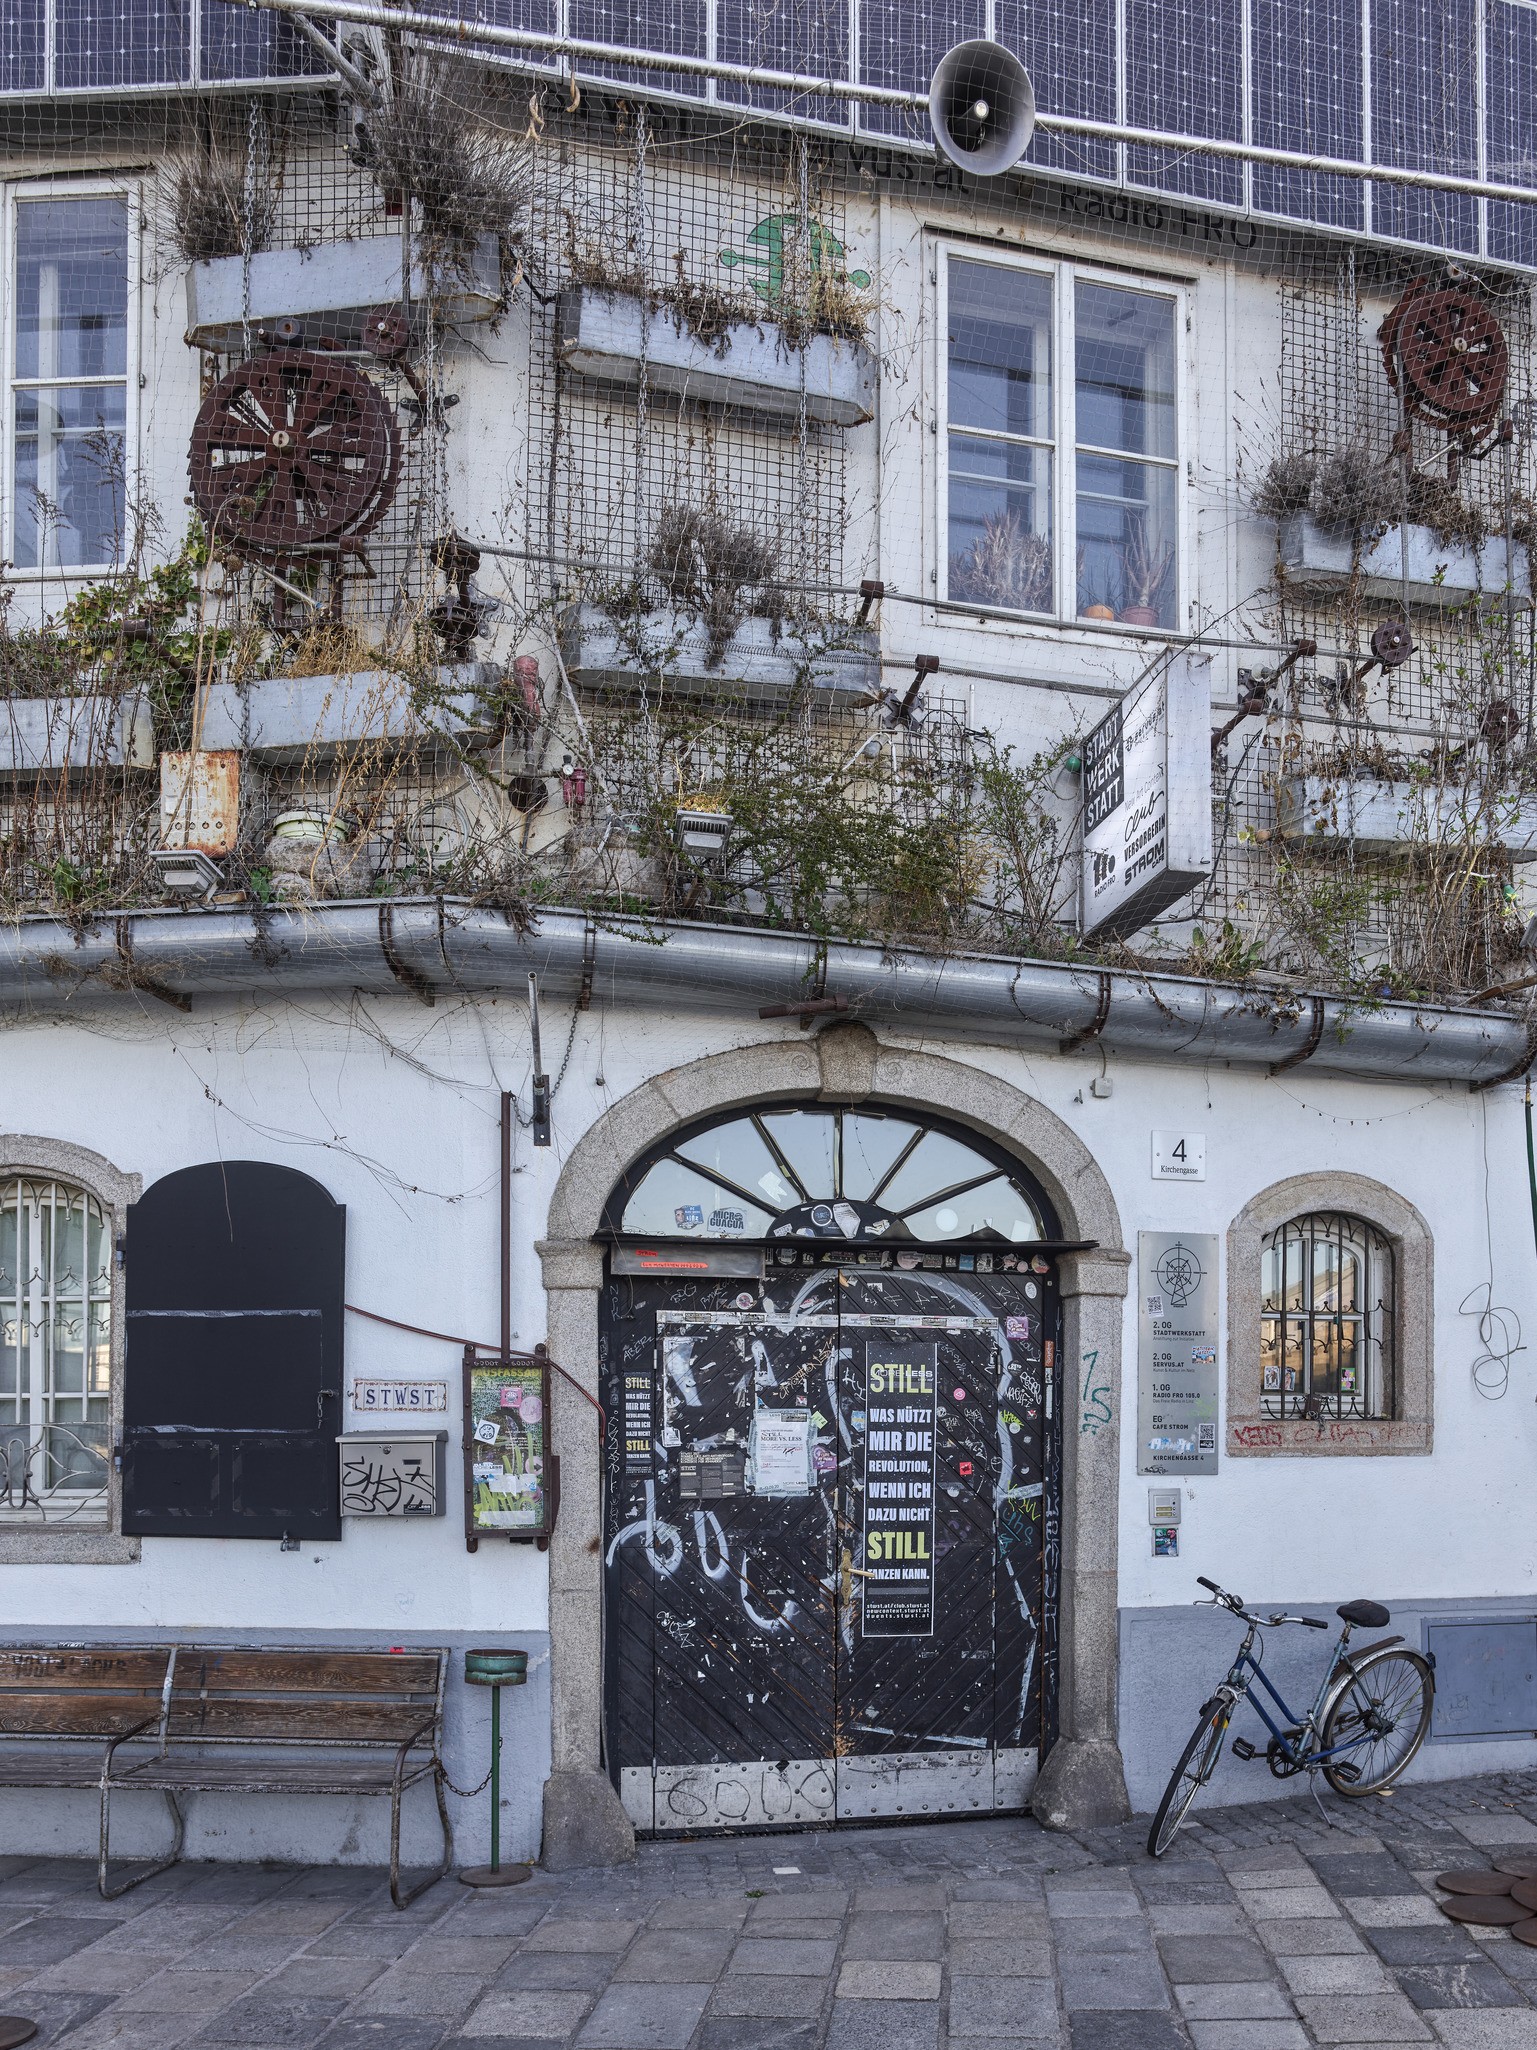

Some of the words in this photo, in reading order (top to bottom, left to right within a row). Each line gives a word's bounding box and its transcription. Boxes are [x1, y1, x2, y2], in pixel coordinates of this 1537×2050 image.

[1060, 183, 1162, 230] Radio
[1180, 208, 1257, 250] FRO
[1086, 711, 1119, 766] STADT
[1087, 743, 1120, 796] WERK
[1087, 776, 1120, 828] STATT
[1124, 813, 1166, 862] VERSORGERIN
[1124, 837, 1165, 886] STROM
[1094, 882, 1107, 898] RADIO
[1107, 874, 1116, 888] FRO
[1171, 1138, 1188, 1163] 4
[1160, 1165, 1199, 1176] Kirchengasse
[710, 1217, 745, 1230] GUAGUA
[1153, 1321, 1160, 1329] 2.
[1161, 1321, 1172, 1329] OG
[1161, 1353, 1172, 1361] OG
[473, 1367, 542, 1377] AUSFASSAD
[870, 1363, 933, 1394] STILL
[905, 1370, 933, 1378] LESS
[625, 1377, 651, 1389] STILL
[366, 1387, 435, 1405] STWST
[625, 1402, 639, 1411] MIR
[640, 1402, 651, 1411] DIE
[870, 1408, 895, 1423] WAS
[897, 1405, 933, 1423] NÜTZT
[1153, 1415, 1163, 1423] EG
[626, 1440, 651, 1451] STILL
[870, 1431, 902, 1451] MIR
[905, 1431, 933, 1451] DIE
[869, 1460, 932, 1473] REVOLUTION,
[869, 1482, 907, 1499] WENN
[908, 1482, 931, 1499] ICH
[868, 1508, 897, 1521] DAZU
[899, 1507, 931, 1521] NICHT
[867, 1531, 930, 1560] STILL
[902, 1568, 930, 1580] KANN.
